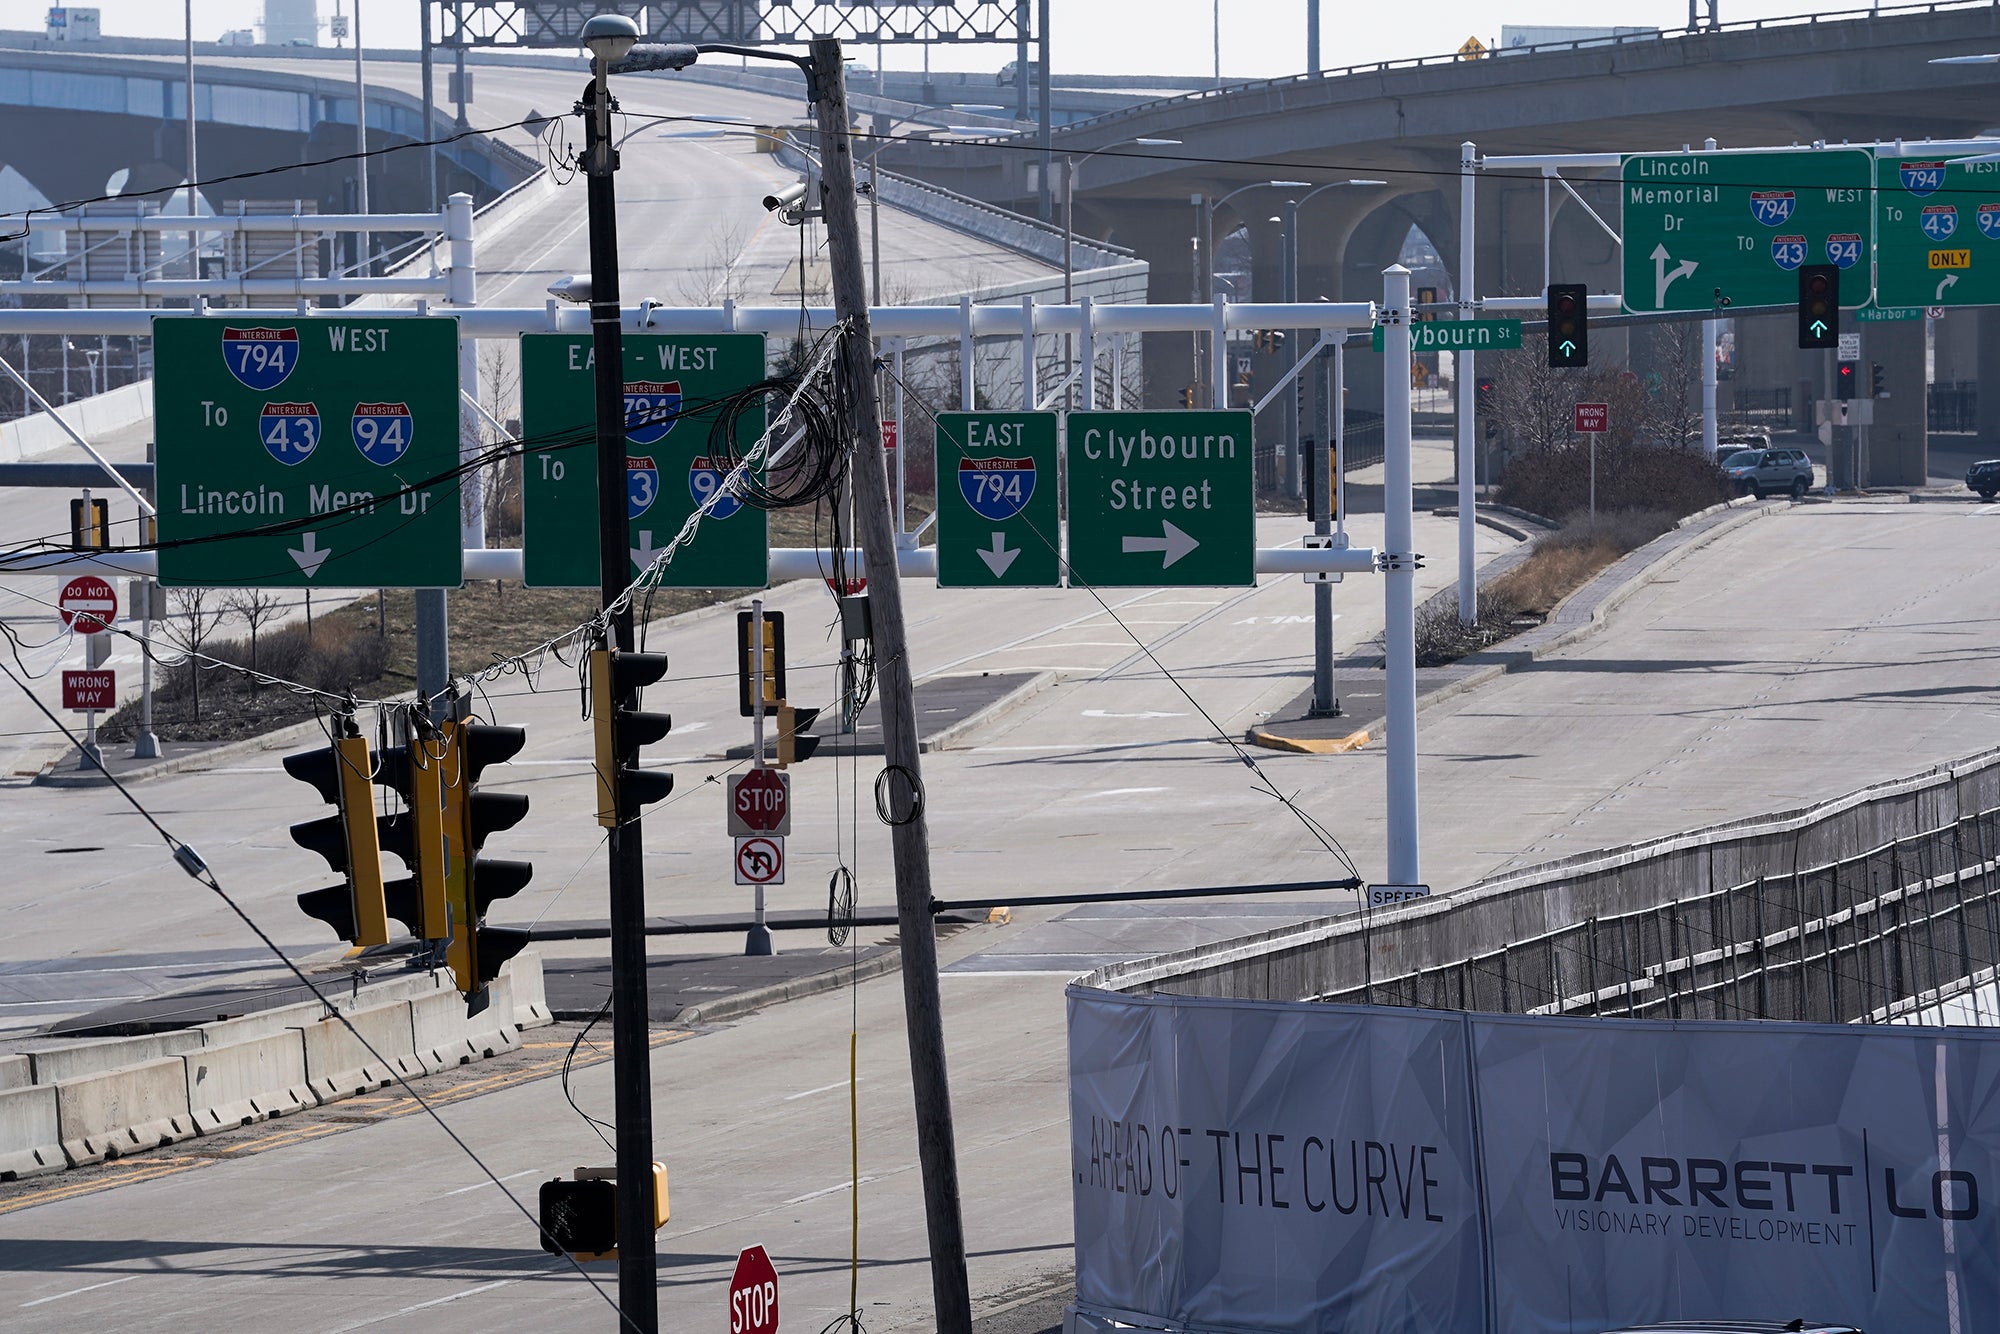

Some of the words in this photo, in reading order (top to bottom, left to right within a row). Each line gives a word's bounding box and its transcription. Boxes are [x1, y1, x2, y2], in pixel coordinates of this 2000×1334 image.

[333, 27, 346, 36] 50
[1640, 159, 1709, 177] Lincoln
[1908, 171, 1937, 188] 794
[1631, 186, 1719, 205] Memorial
[1826, 189, 1864, 203] WEST
[1756, 200, 1788, 219] 794
[1886, 207, 1903, 222] To
[1664, 213, 1684, 231] Dr
[1924, 214, 1955, 234] 43
[1737, 235, 1754, 251] TO
[1829, 242, 1857, 262] 94
[1775, 244, 1804, 264] 43
[1931, 252, 1967, 267] ONLY
[1868, 309, 1906, 320] Harbor
[239, 331, 281, 340] INTERSTATE
[328, 326, 389, 352] WEST
[1409, 325, 1489, 351] ybourn
[1498, 327, 1509, 339] St
[237, 345, 285, 373] 794
[658, 344, 717, 371] WEST
[201, 401, 227, 426] To
[268, 406, 310, 415] INTERSTATE
[360, 406, 402, 415] INTERSTATE
[623, 398, 667, 427] 794
[1579, 408, 1604, 417] WRONG
[967, 421, 1024, 447] EAST
[1584, 420, 1599, 428] WAY
[266, 418, 315, 452] 43
[357, 418, 404, 452] 94
[1084, 428, 1235, 467] Clybourn
[539, 454, 565, 481] To
[627, 460, 648, 469] STATE
[976, 460, 1018, 470] INTERSTATE
[631, 472, 653, 506] 3
[972, 474, 1021, 503] 794
[1110, 479, 1211, 510] Street
[181, 484, 284, 514] Lincoln
[310, 484, 375, 515] Mem
[400, 485, 431, 515] Dr
[67, 587, 82, 597] DO
[88, 587, 109, 597] NOT
[68, 676, 110, 688] WRONG
[77, 691, 101, 703] WAY
[738, 788, 783, 811] STOP
[1090, 1115, 1152, 1197] AHEAD
[1161, 1125, 1191, 1200] OF
[1206, 1130, 1289, 1208] THE
[1303, 1136, 1443, 1222] CURVE
[1551, 1153, 1853, 1214] BARRETT
[1886, 1167, 1979, 1221] LO
[1555, 1209, 1672, 1236] VISIONARY
[1683, 1214, 1857, 1247] DEVELOPMENT
[733, 1281, 775, 1334] STOP
